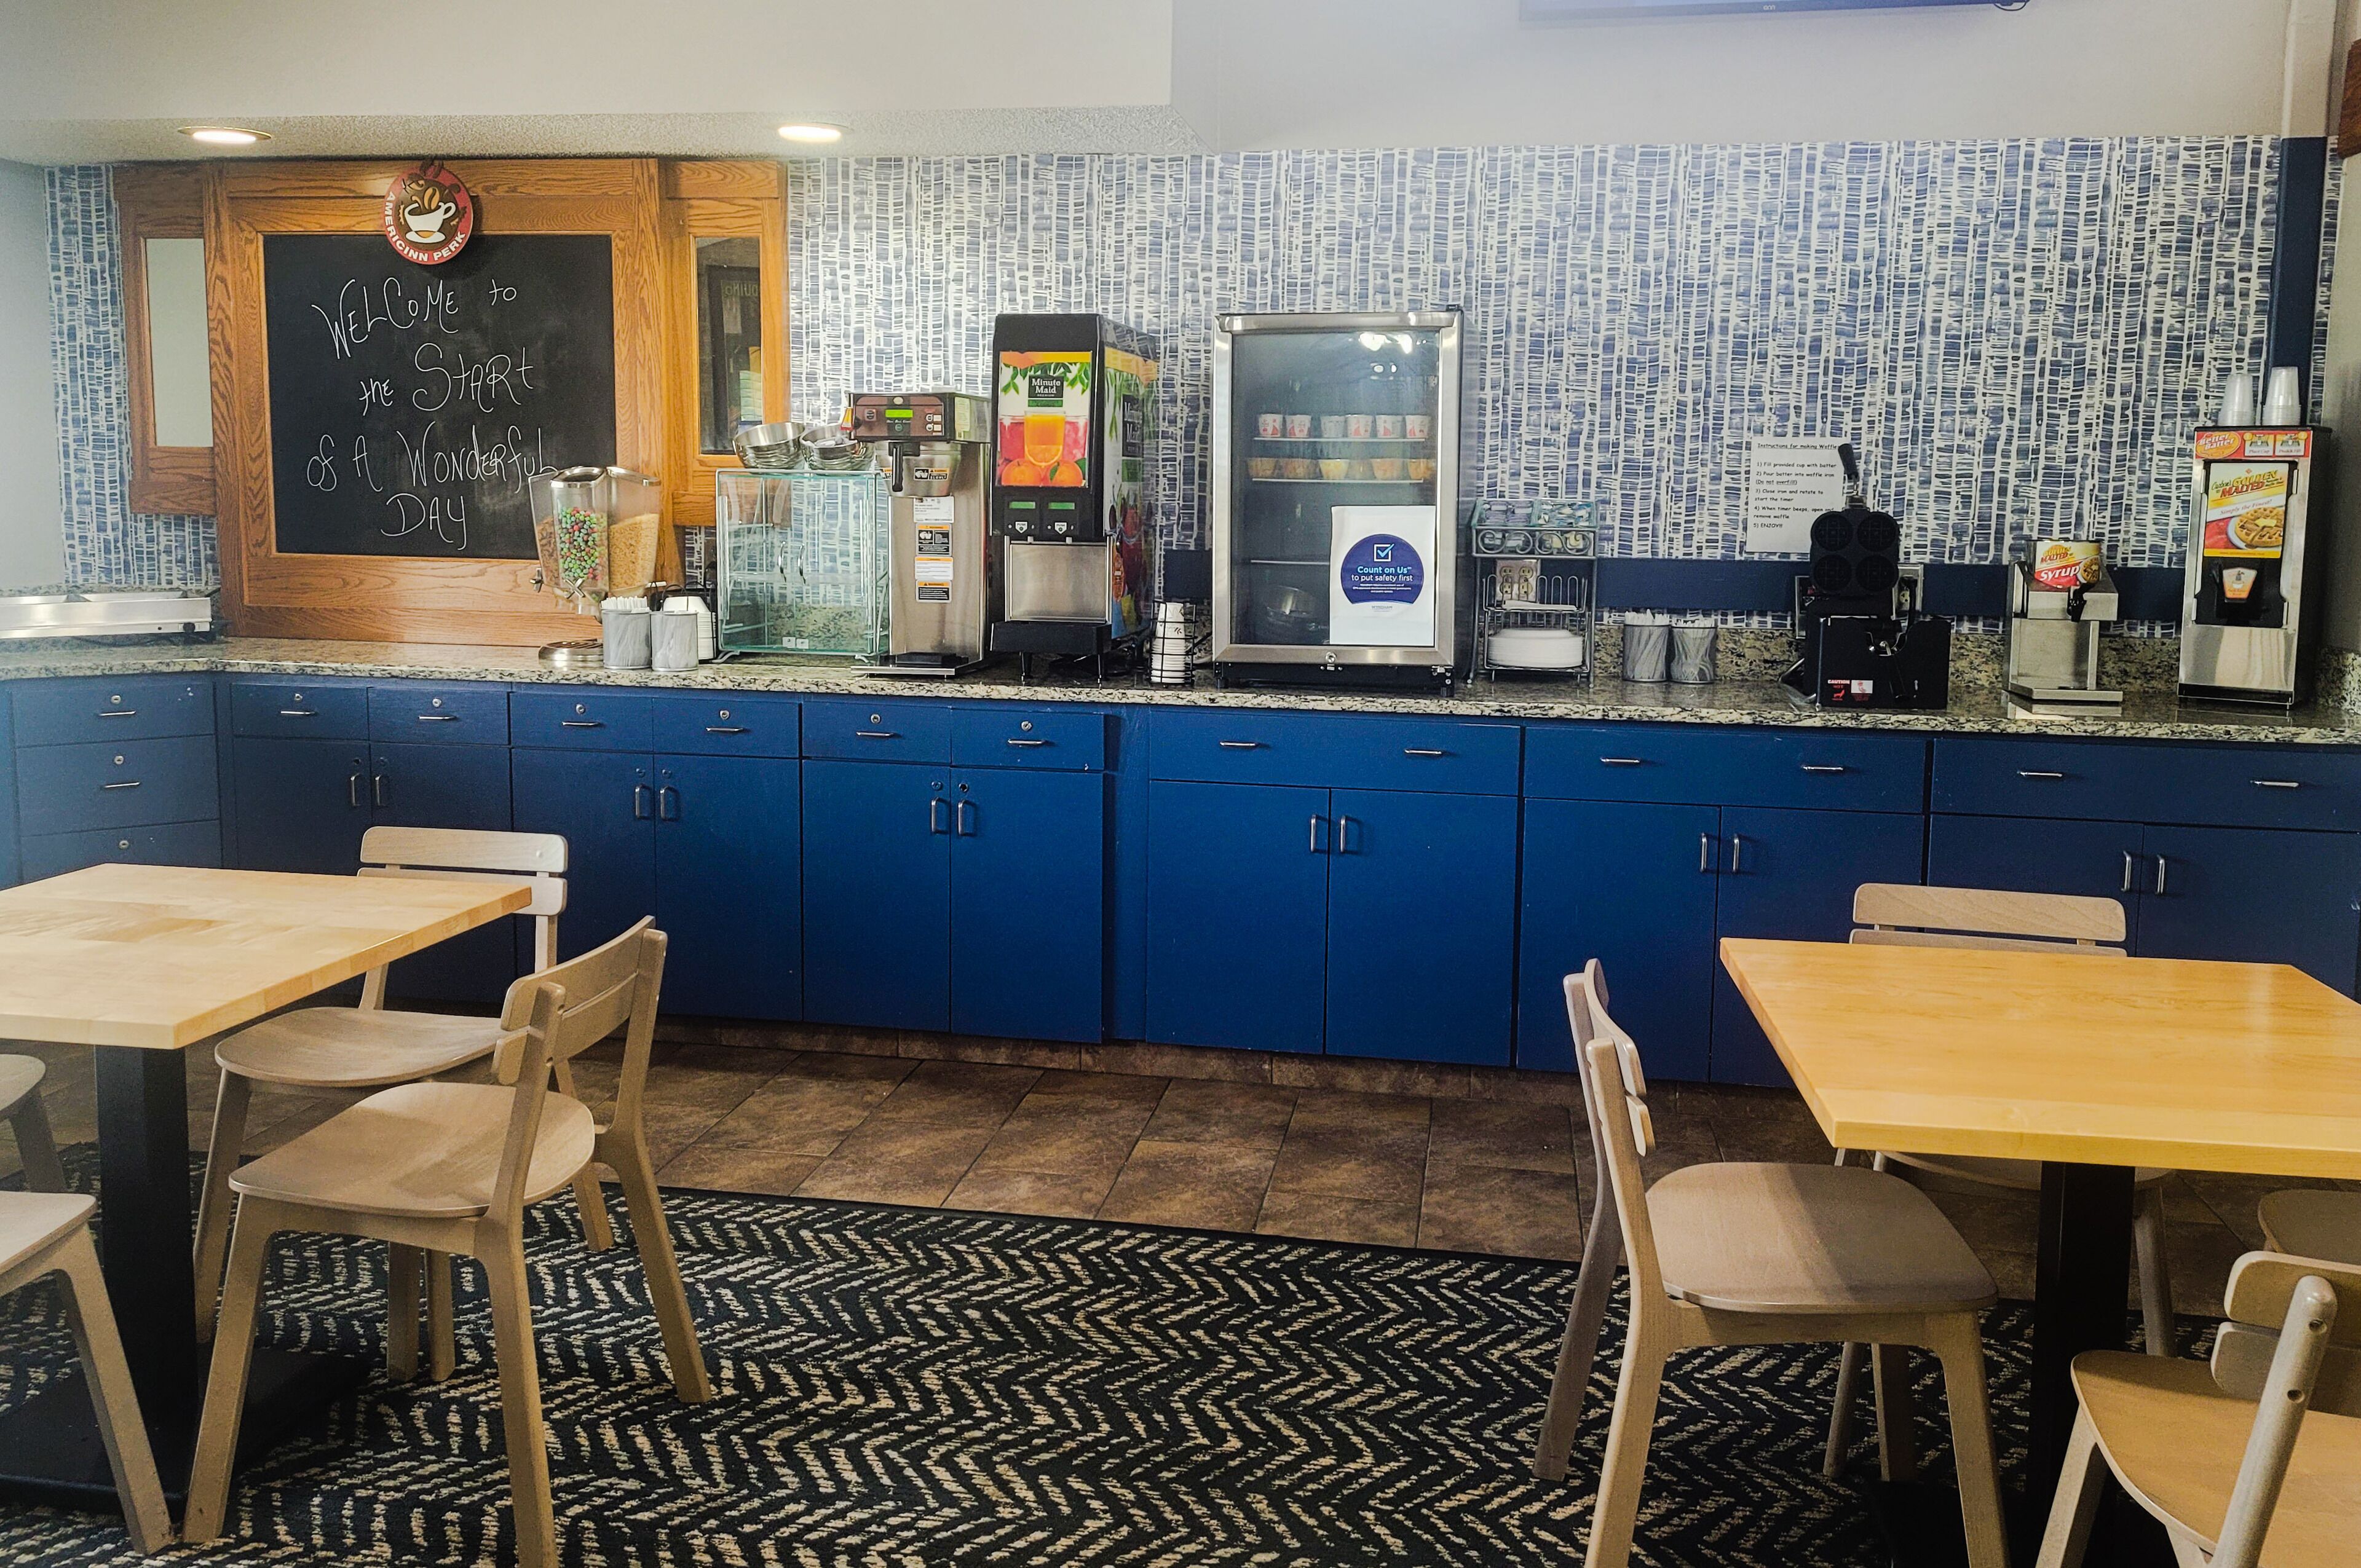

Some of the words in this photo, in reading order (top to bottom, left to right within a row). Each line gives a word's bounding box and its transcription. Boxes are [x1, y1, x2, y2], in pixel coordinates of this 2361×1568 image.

[384, 191, 429, 262] AMERICINN
[433, 231, 465, 261] PERK
[489, 279, 517, 305] to
[354, 435, 382, 492] A
[2220, 482, 2264, 498] MALTED
[381, 492, 467, 551] DAY
[2039, 565, 2079, 581] Syrup
